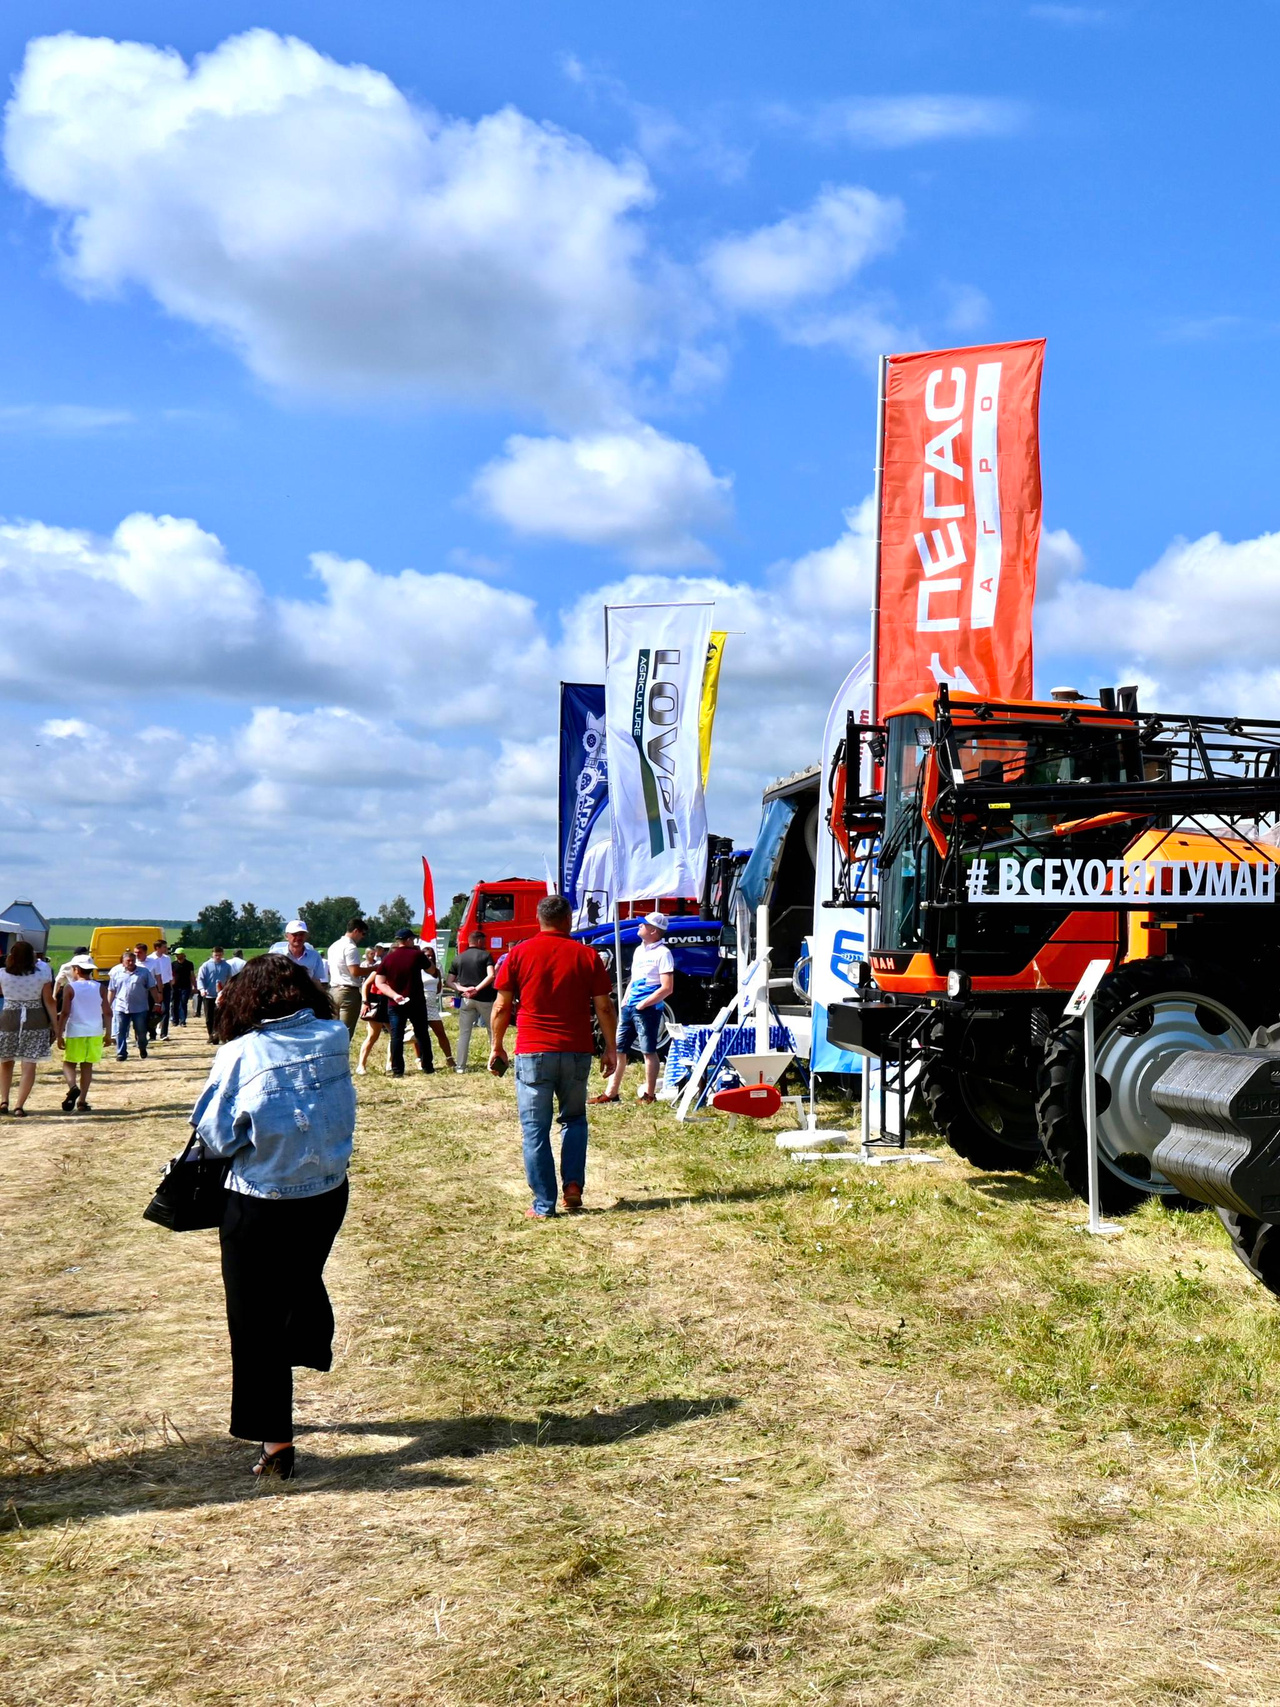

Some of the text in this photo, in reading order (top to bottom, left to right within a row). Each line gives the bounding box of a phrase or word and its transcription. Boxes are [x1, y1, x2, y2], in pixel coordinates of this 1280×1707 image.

[914, 366, 967, 632] ПЕГАС
[979, 396, 997, 592] АГРО
[633, 655, 647, 737] AGRICULTURE
[661, 935, 704, 945] LOVOL
